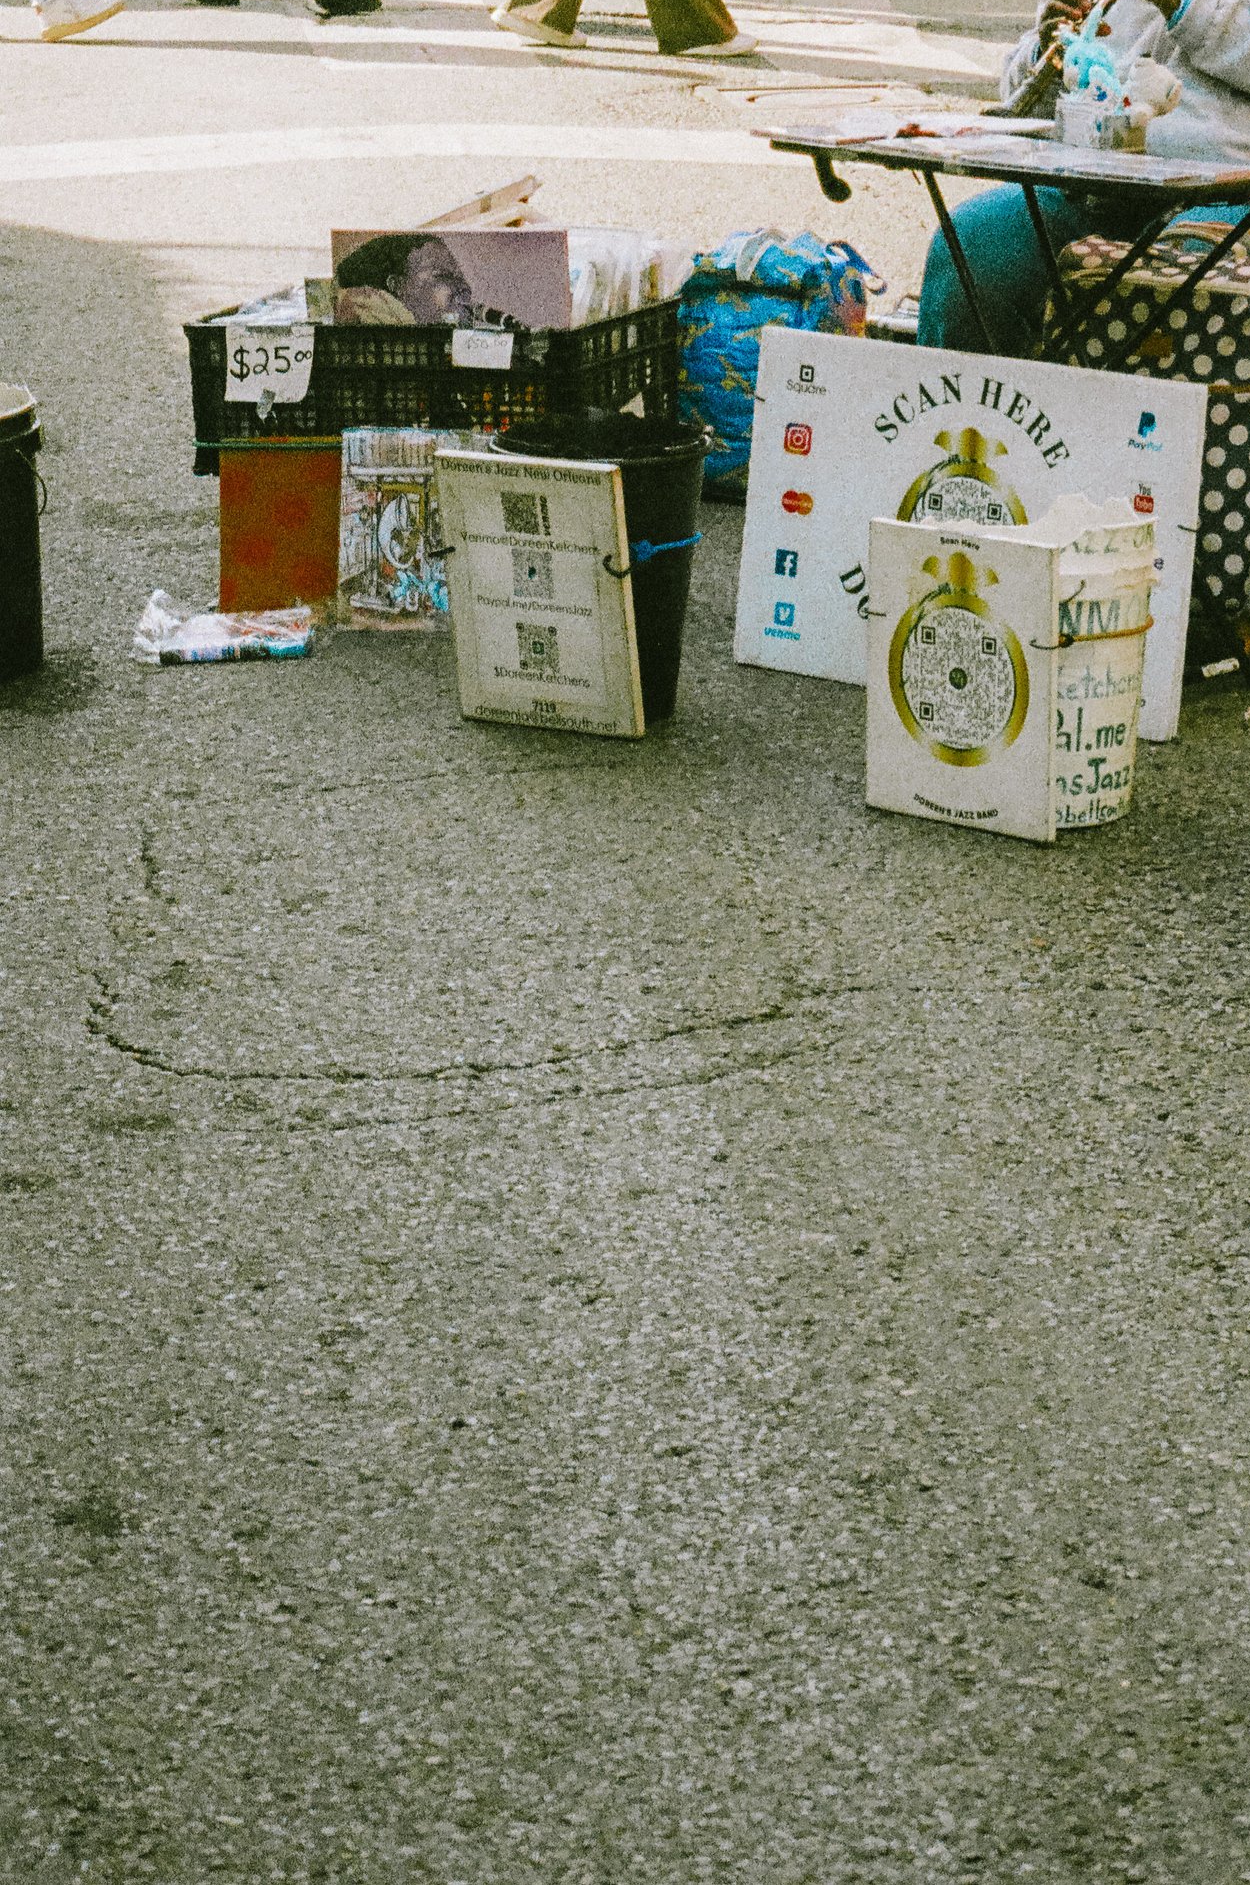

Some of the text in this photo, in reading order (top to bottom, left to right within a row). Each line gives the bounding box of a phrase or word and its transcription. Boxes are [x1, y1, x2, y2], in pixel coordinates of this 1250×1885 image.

[786, 379, 827, 396] Square
[874, 373, 1071, 469] SCAN HERE
[940, 536, 980, 551] Scan Here
[764, 627, 800, 641] venmo
[954, 809, 975, 820] JAZZ
[976, 808, 999, 820] BAND
